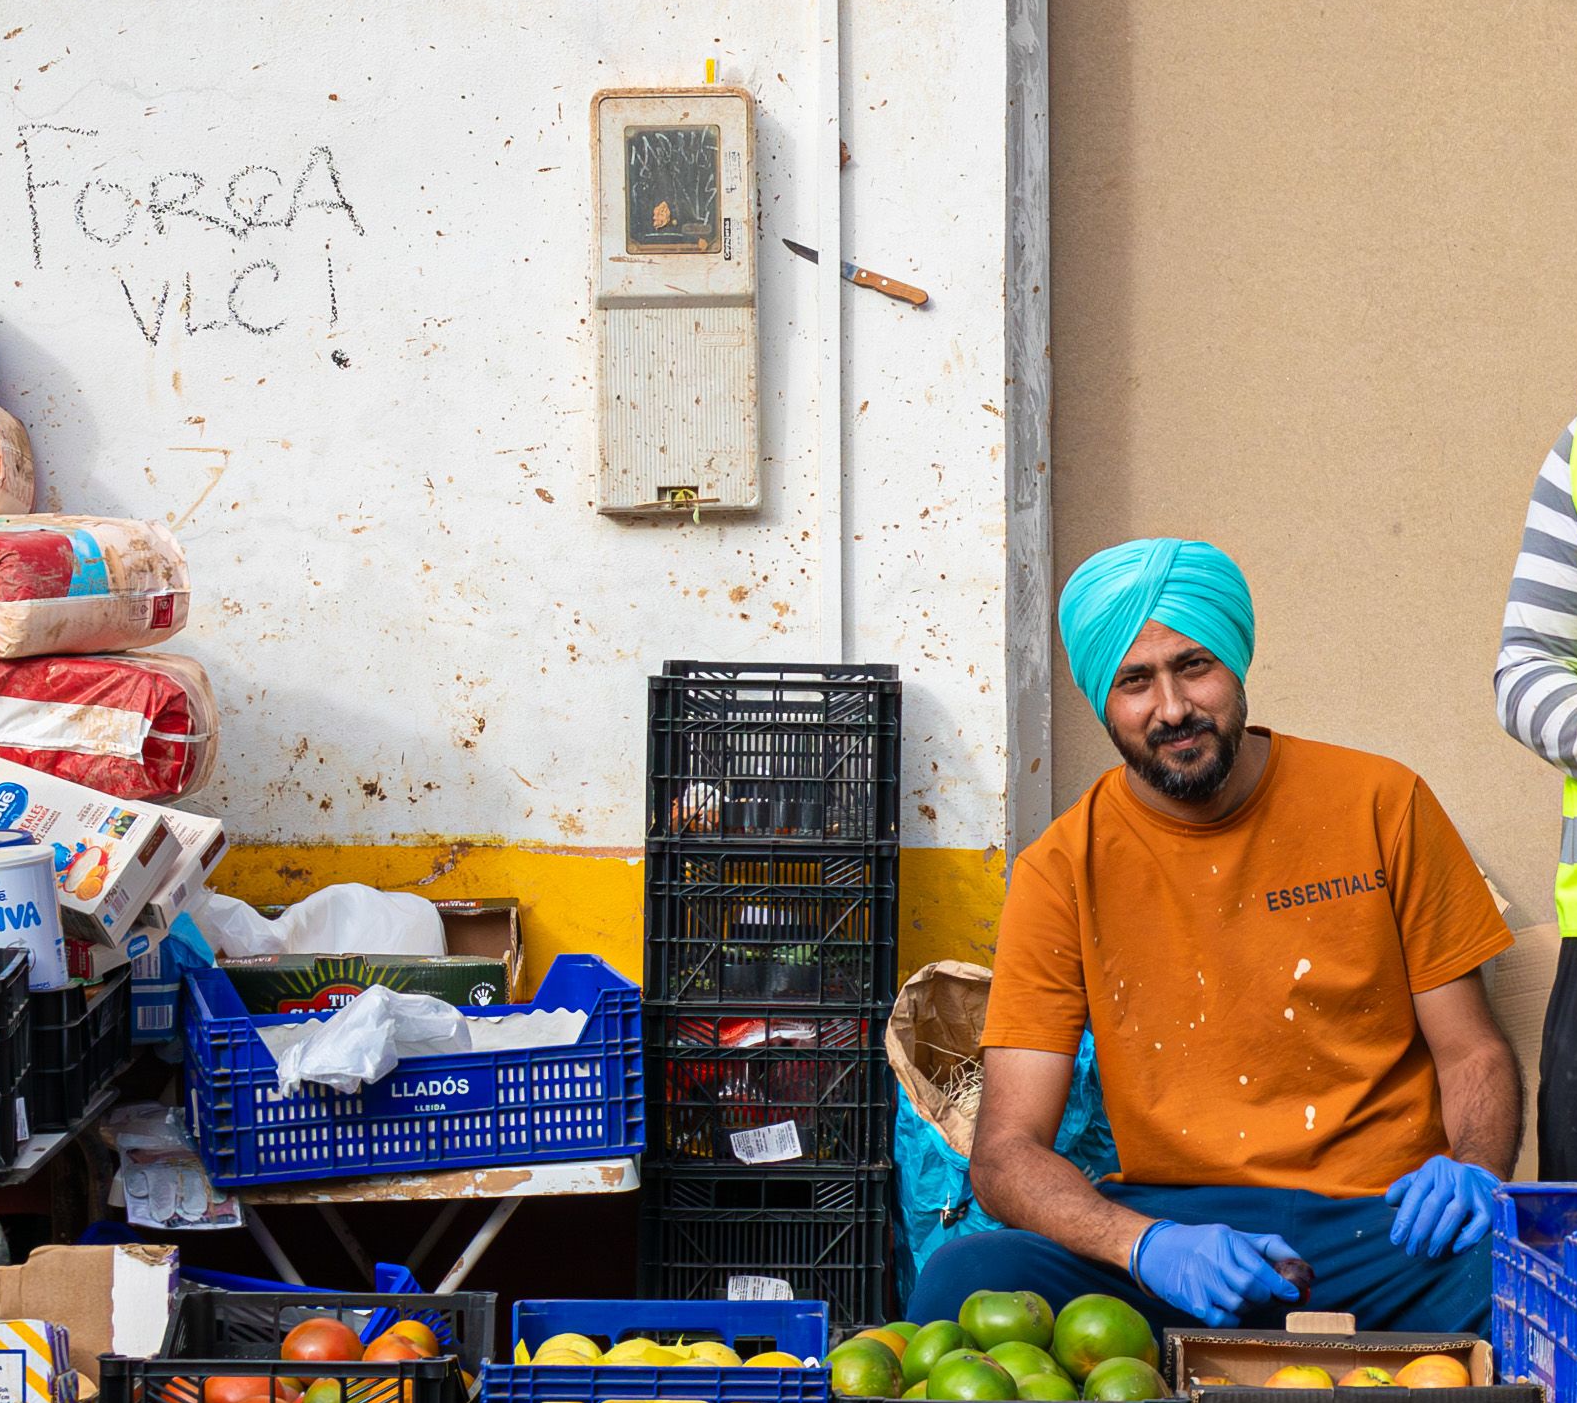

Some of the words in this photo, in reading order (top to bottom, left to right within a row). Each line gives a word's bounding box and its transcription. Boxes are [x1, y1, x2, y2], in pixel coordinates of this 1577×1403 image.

[19, 801, 45, 833] EALES
[1265, 869, 1387, 912] ESSENTIALS
[391, 1075, 470, 1099] LLADÓS
